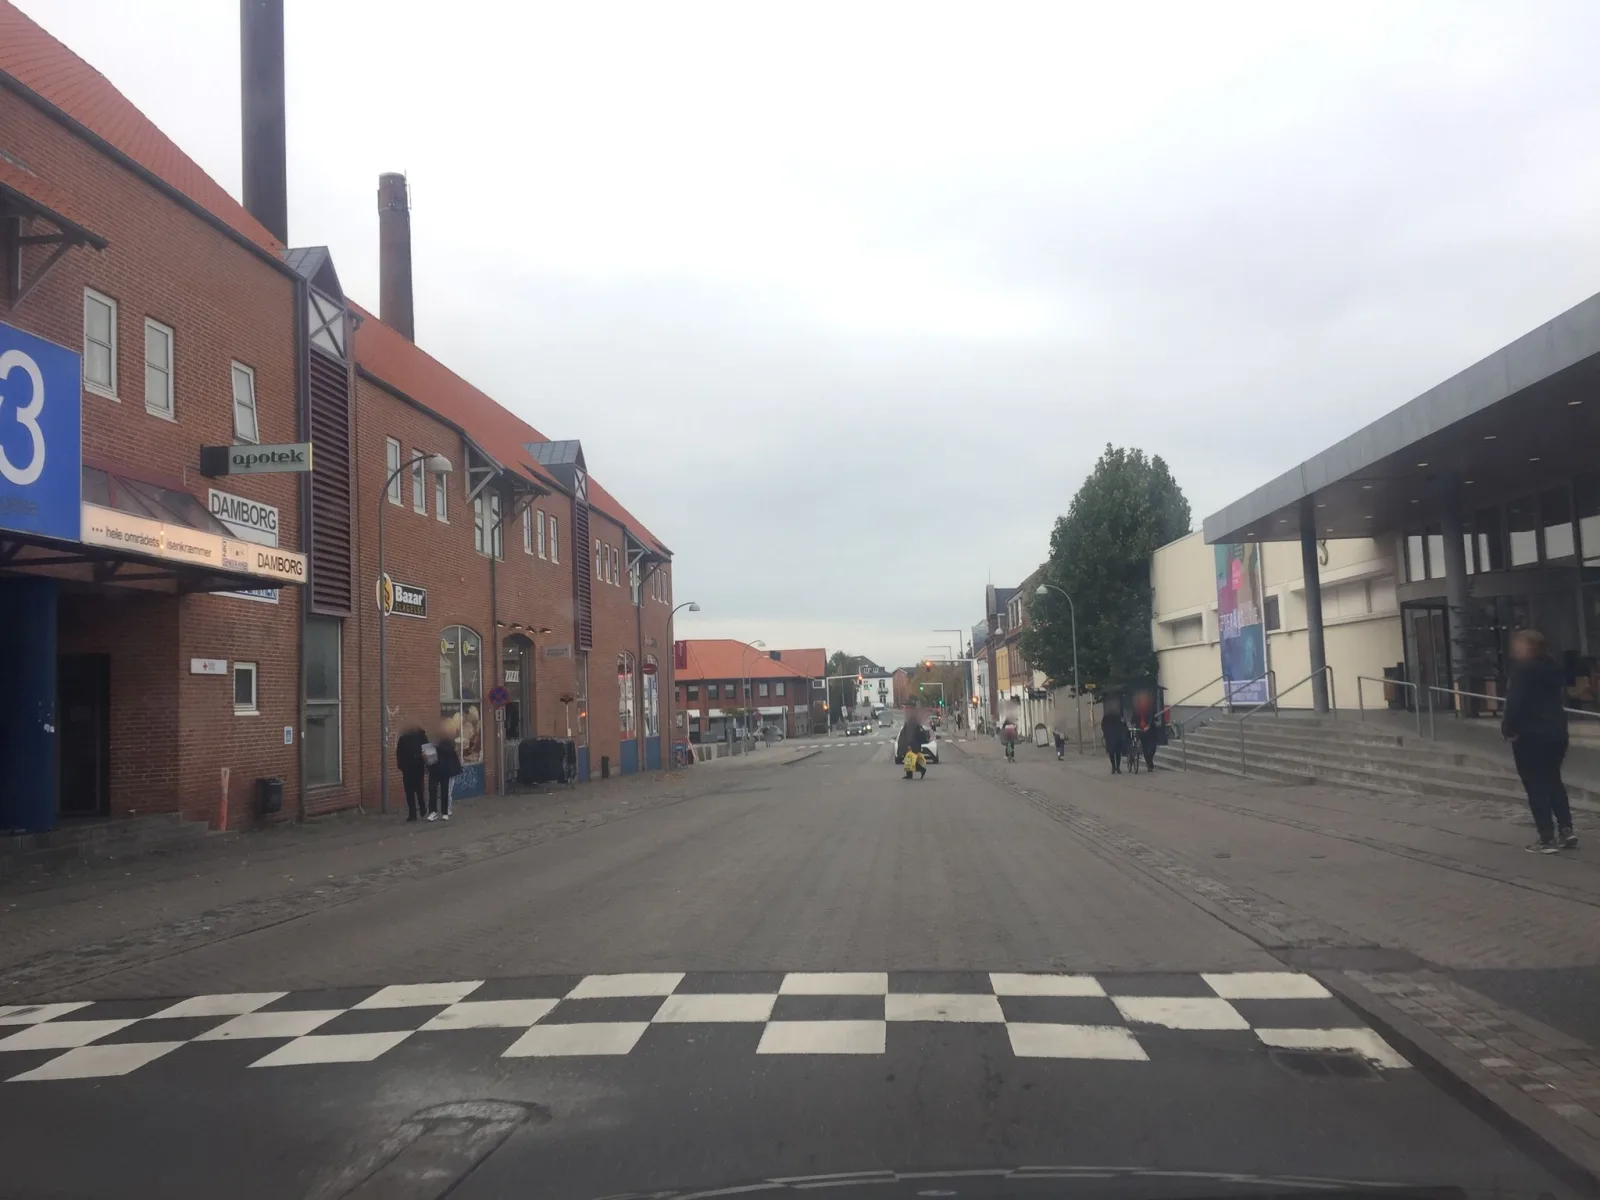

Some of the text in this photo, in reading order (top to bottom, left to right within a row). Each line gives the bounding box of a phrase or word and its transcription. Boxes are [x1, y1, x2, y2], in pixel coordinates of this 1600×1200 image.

[232, 449, 304, 468] apotek
[211, 493, 276, 530] DAMBORG
[105, 525, 123, 541] hele
[257, 553, 302, 575] DAMBORG
[395, 585, 423, 606] Bazar
